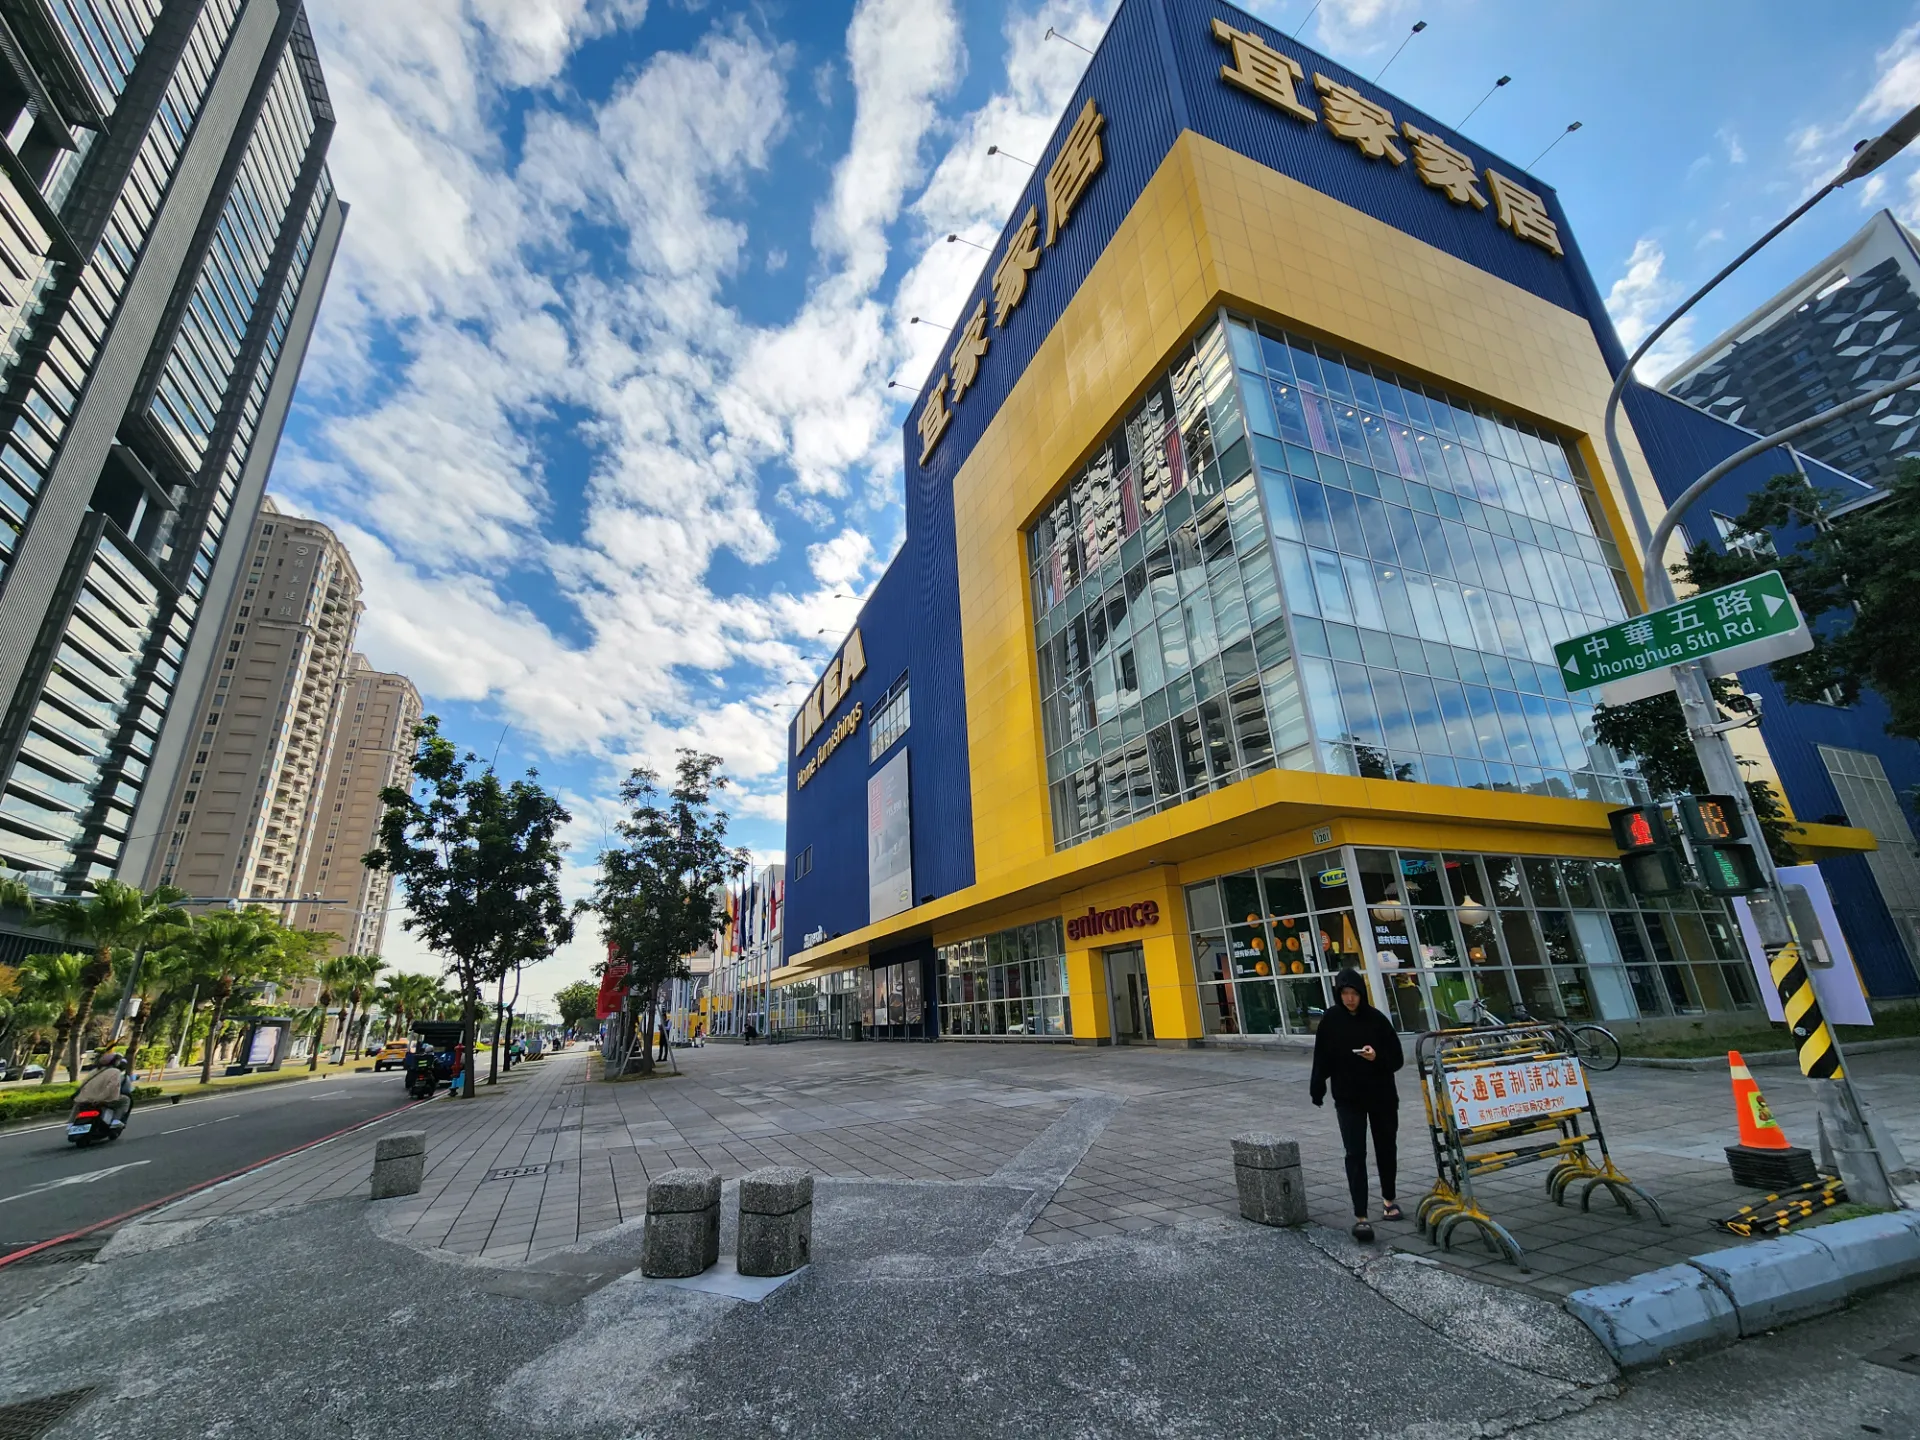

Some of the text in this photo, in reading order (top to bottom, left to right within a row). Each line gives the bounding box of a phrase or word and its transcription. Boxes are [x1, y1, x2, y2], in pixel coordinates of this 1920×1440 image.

[1211, 17, 1564, 258] 宜家家居
[918, 96, 1104, 467] 宜家家居
[1583, 588, 1752, 659] 中華五路
[1590, 617, 1763, 680] Jhonghua 5th Rd.
[796, 628, 866, 756] IKEA
[797, 701, 863, 791] Home furnishings
[1316, 833, 1330, 843] 1201
[1699, 802, 1730, 838] 18
[1322, 873, 1347, 883] IKEA
[1067, 900, 1159, 940] entrance
[1450, 1064, 1578, 1103] 交通管制請改道
